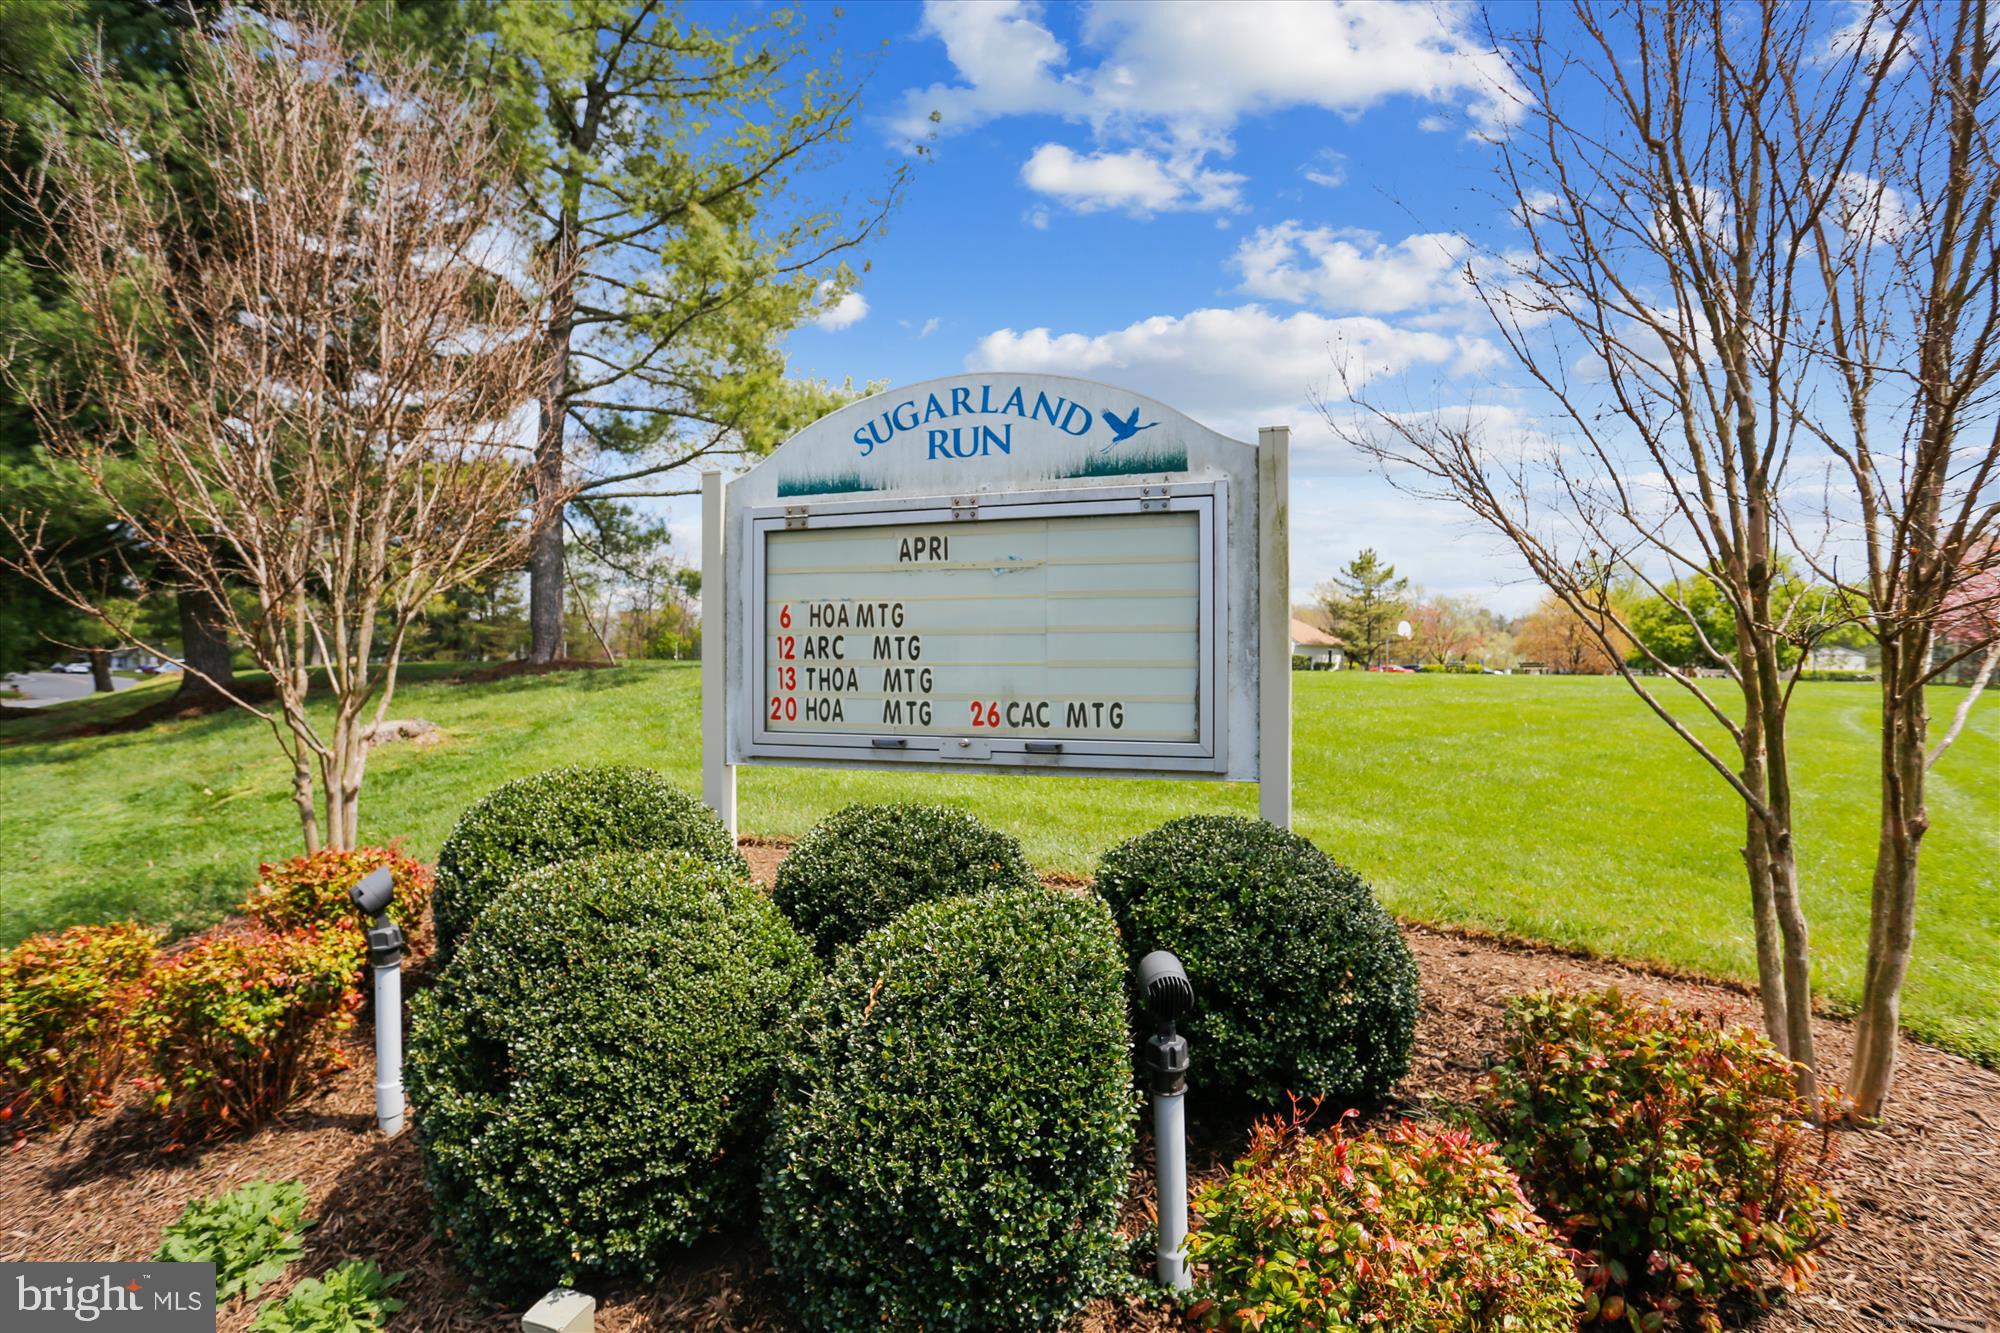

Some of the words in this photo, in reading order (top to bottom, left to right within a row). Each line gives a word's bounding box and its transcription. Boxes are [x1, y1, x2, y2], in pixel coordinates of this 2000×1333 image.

[853, 385, 1093, 457] SUGARLAND
[927, 423, 1013, 460] RUN
[899, 536, 949, 562] APRI
[779, 605, 791, 628] 6
[809, 604, 849, 628] HOA
[856, 603, 904, 628] MTG
[777, 636, 795, 660] 12
[803, 636, 844, 660] ARC
[873, 636, 921, 661] MTG
[778, 667, 797, 691] 13
[806, 667, 859, 692] THOA
[883, 668, 933, 693] MTG
[770, 697, 797, 722] 20
[806, 698, 844, 723] HOA
[883, 700, 932, 726] MTG
[970, 701, 1000, 728] 26
[1006, 702, 1051, 728] CAC
[1066, 702, 1124, 729] MTG
